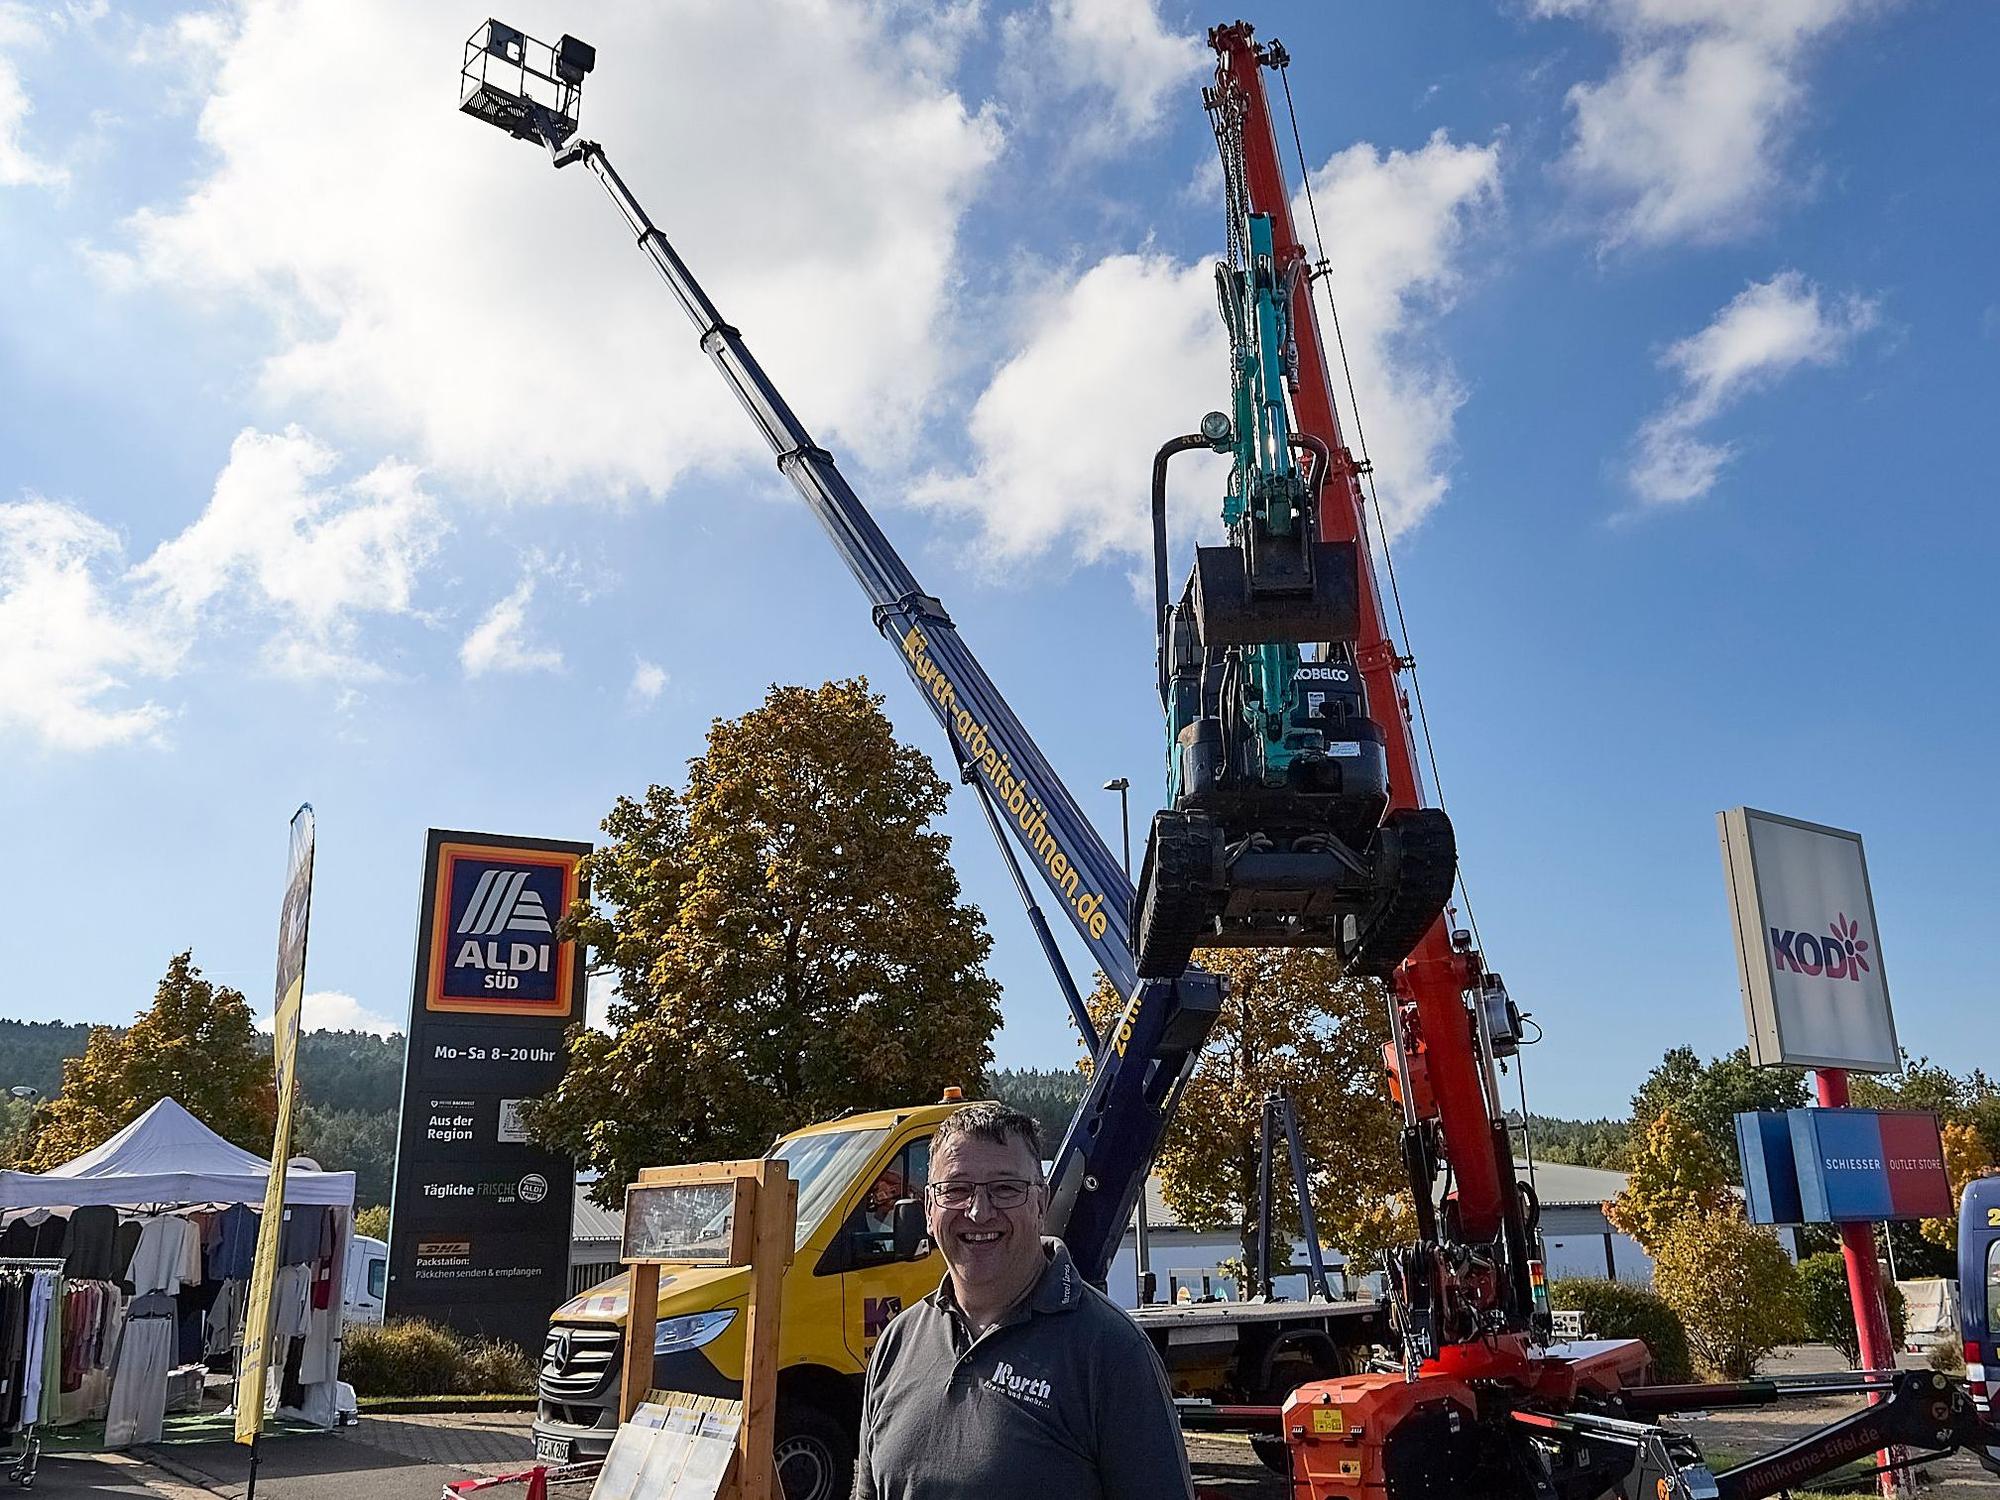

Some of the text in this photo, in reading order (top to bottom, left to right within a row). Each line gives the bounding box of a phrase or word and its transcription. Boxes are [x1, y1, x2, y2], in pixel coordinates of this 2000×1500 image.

[1293, 667, 1350, 682] KOBELCO
[454, 940, 550, 972] ALDI
[484, 970, 519, 990] SÜD
[530, 1048, 556, 1062] Uhr
[428, 1115, 474, 1127] Aus der
[427, 1127, 474, 1142] Region
[1825, 1158, 1943, 1170] SCHIESSER OUTLET STORE
[423, 1183, 516, 1199] Tägliche FRISCHE
[522, 1184, 543, 1193] ALDI
[497, 1195, 515, 1203] zum
[425, 1244, 462, 1254] DHL
[416, 1256, 470, 1267] Packstation:
[415, 1266, 542, 1279] Päckchen senden & empfangen
[991, 1361, 1051, 1399] Kurth
